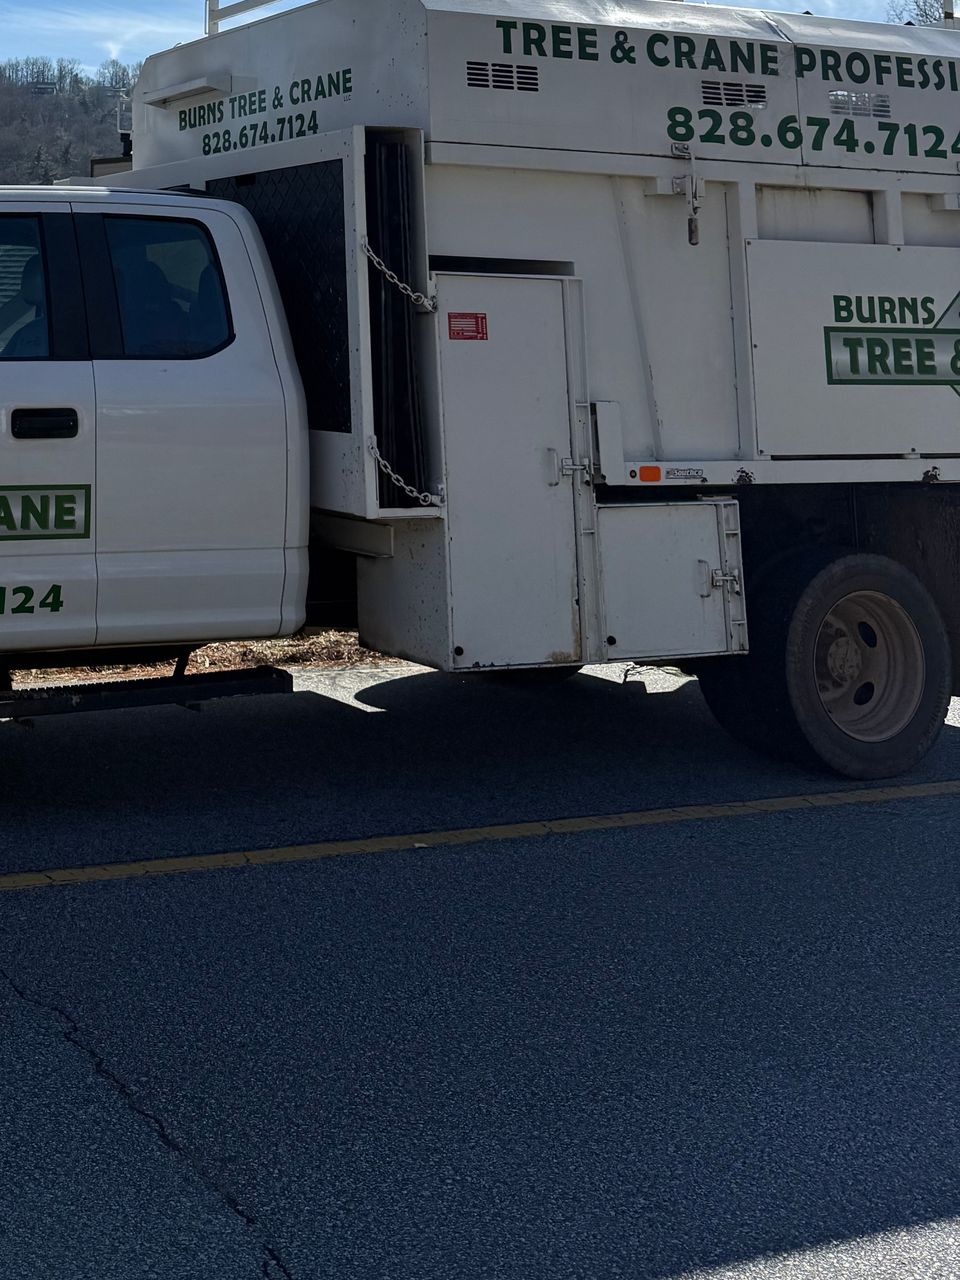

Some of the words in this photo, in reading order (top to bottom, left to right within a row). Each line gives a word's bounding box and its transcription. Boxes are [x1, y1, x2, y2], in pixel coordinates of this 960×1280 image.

[496, 20, 599, 61] TREE
[610, 30, 636, 64] &
[646, 33, 779, 76] CRANE
[795, 46, 959, 91] PROFESSI
[179, 100, 224, 131] BURNS
[229, 89, 266, 119] TREE
[272, 86, 283, 110] &
[290, 68, 352, 105] CRANE
[202, 110, 319, 156] 828.674.7124
[832, 295, 936, 325] BURNS
[843, 337, 937, 375] TREE
